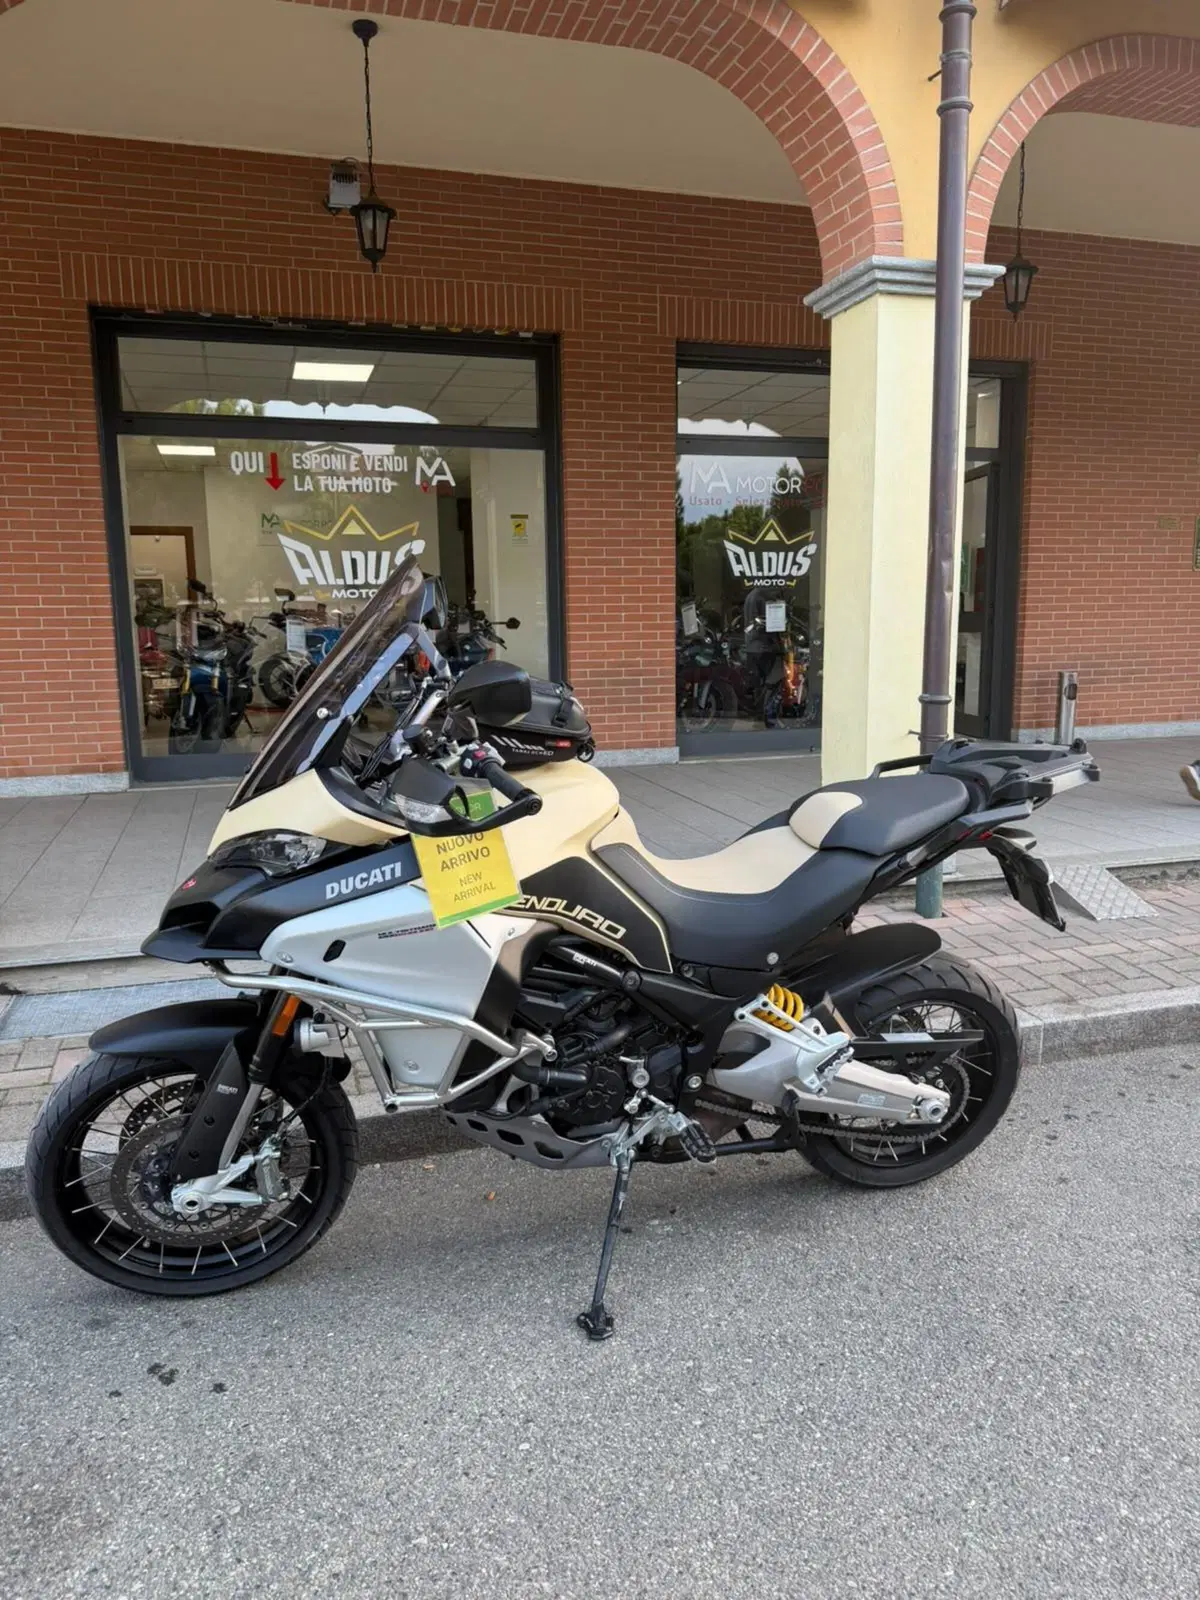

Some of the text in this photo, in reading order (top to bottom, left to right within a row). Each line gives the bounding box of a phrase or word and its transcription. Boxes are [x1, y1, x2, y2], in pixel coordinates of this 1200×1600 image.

[230, 451, 265, 475] QUI
[292, 453, 408, 472] ESPONI E VENDI
[294, 475, 391, 493] LA TUA MOTO
[690, 496, 722, 506] Usato
[723, 539, 818, 577] ALDUS
[753, 579, 786, 587] MOTO
[436, 831, 485, 855] NUOVO
[440, 846, 491, 872] ARRIVO
[325, 861, 402, 900] DUCATI
[459, 872, 482, 887] NEW
[453, 881, 496, 903] ARRIVAL
[512, 894, 627, 940] ENDURO
